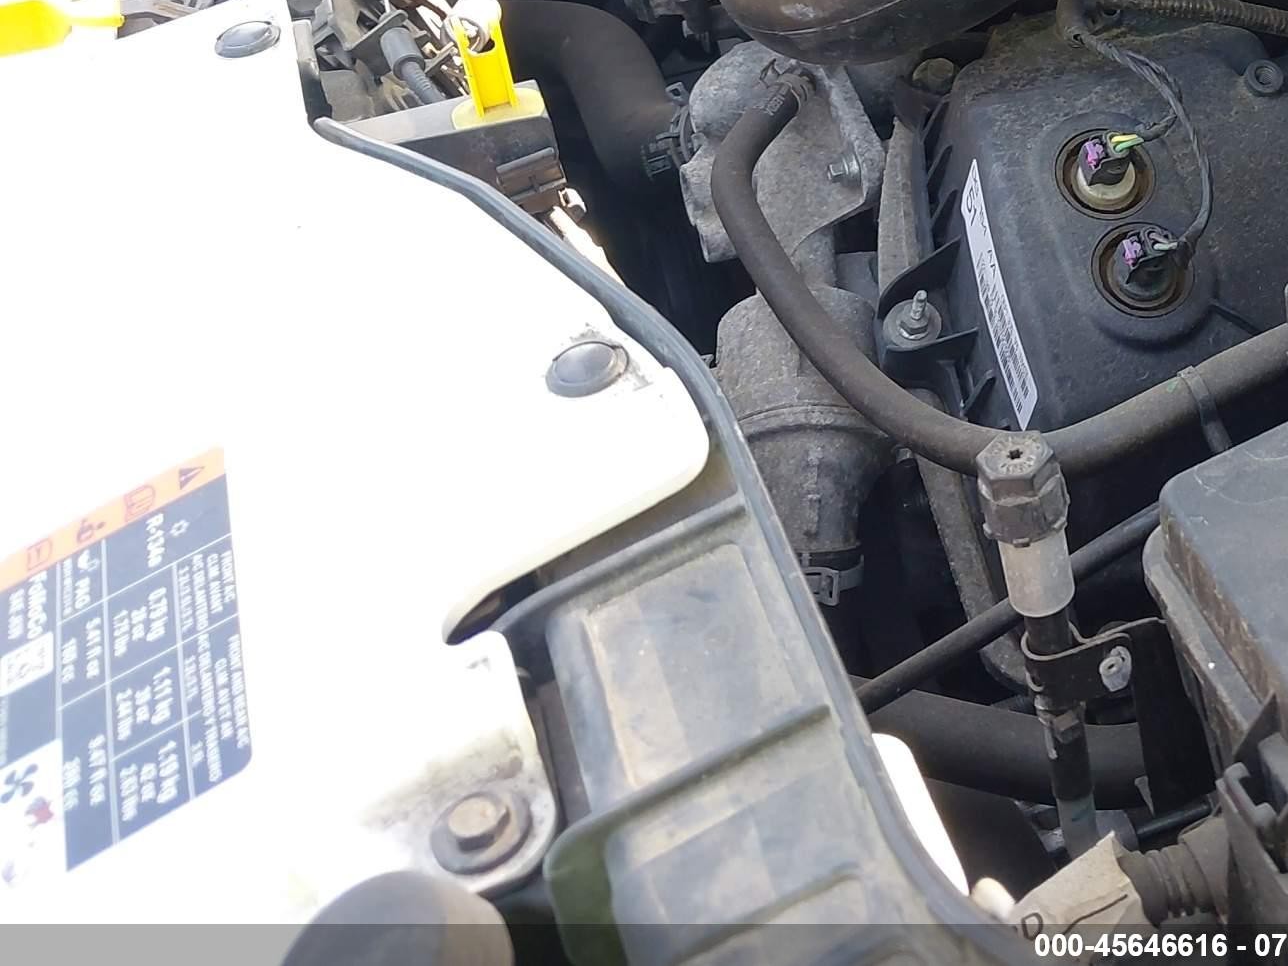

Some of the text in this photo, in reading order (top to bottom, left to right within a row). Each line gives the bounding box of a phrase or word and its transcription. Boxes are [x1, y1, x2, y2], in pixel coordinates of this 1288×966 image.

[145, 512, 165, 570] R-134a
[29, 570, 49, 638] FoMoCo
[152, 665, 171, 701] 1.11
